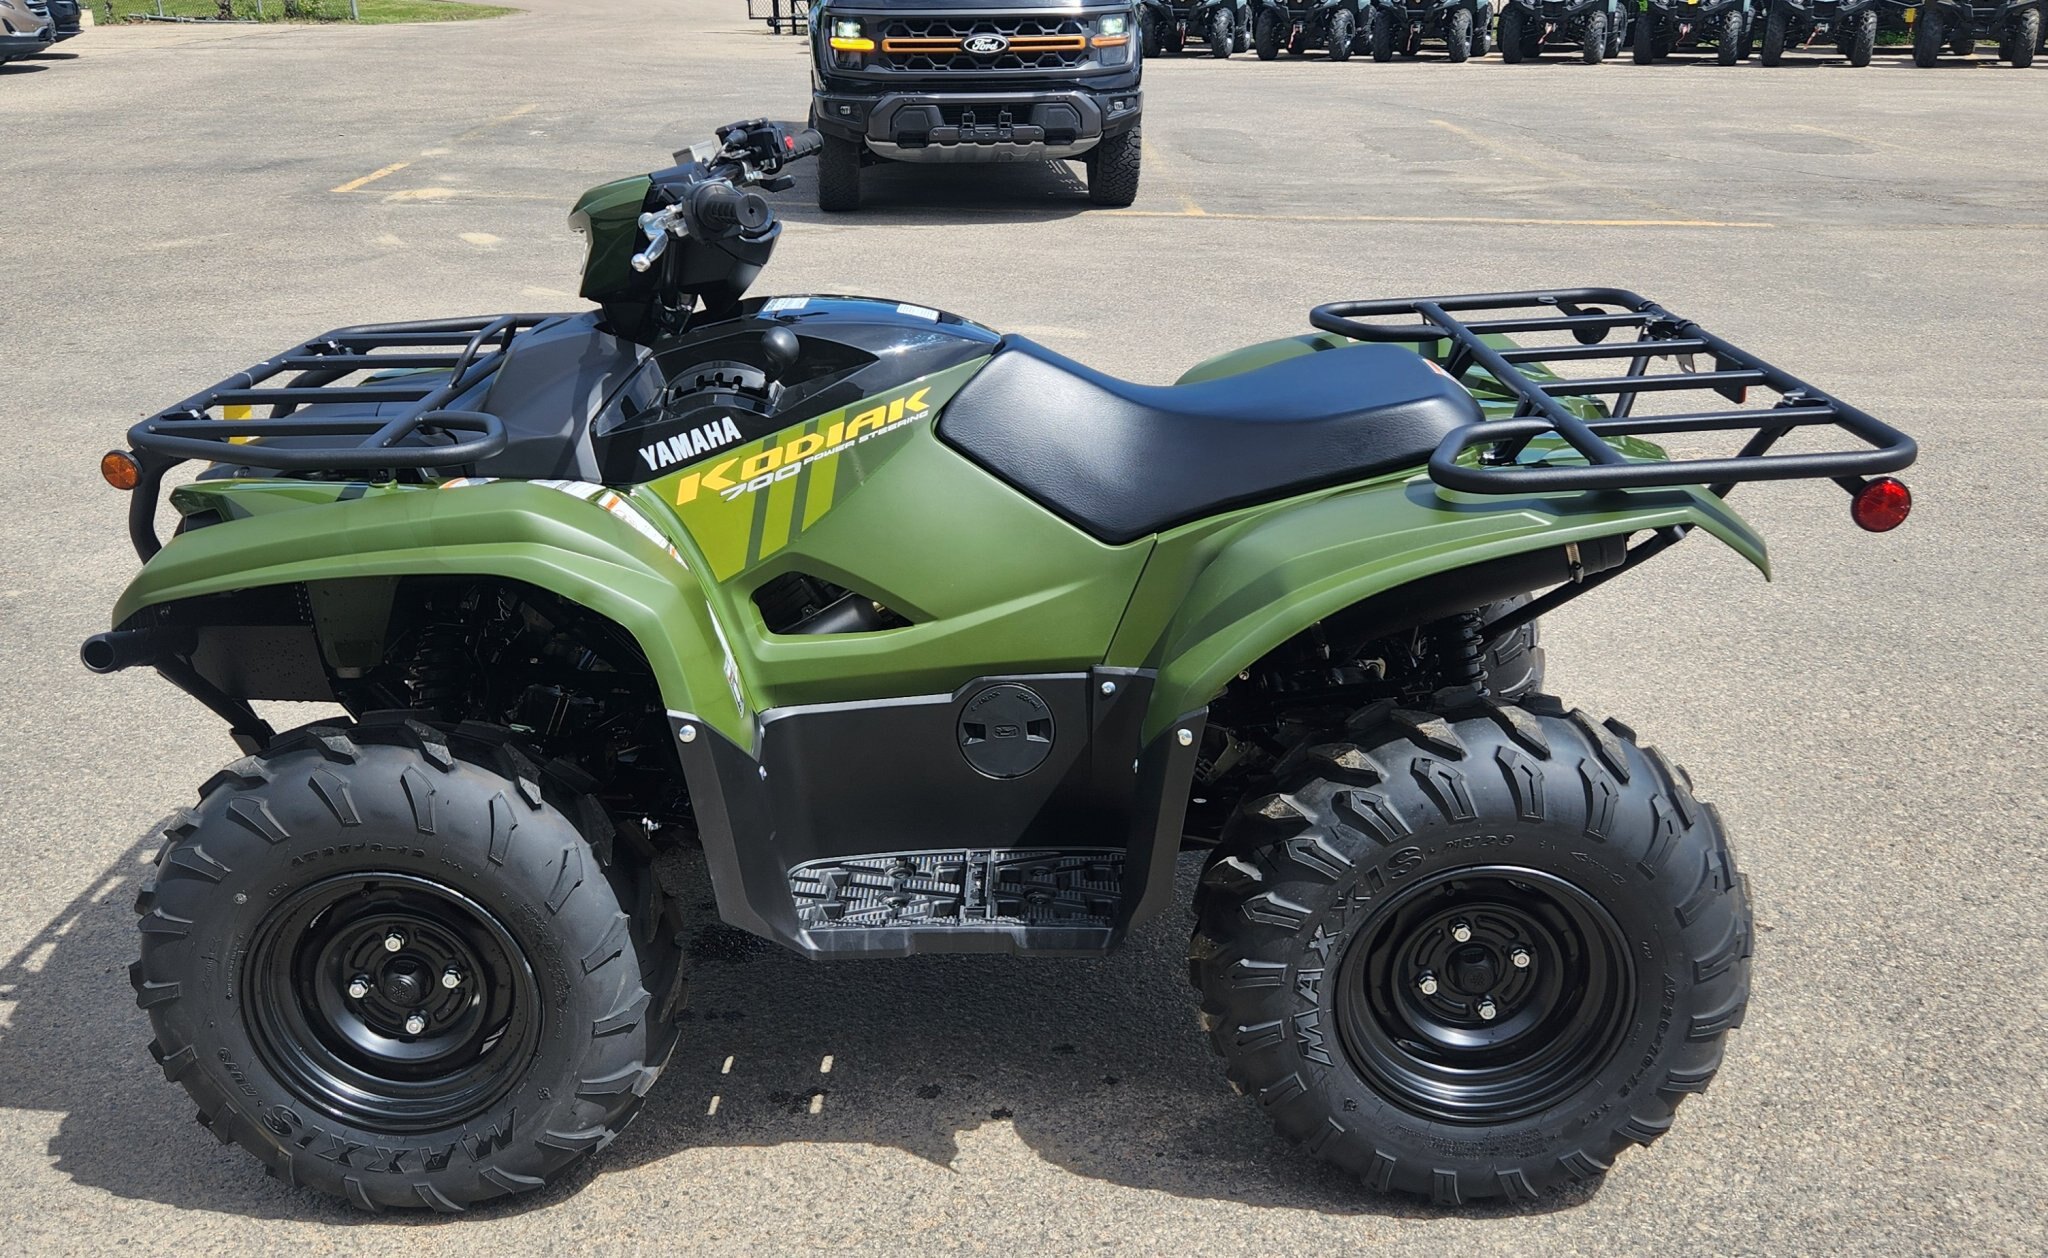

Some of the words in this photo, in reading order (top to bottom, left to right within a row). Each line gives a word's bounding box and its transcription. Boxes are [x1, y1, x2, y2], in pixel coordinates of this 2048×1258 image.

[969, 37, 1001, 51] Ford
[638, 416, 742, 471] YAMAHA
[676, 386, 932, 506] KODIAK
[719, 461, 802, 504] 700
[803, 440, 856, 466] POWER
[858, 410, 929, 444] STEERING
[1295, 843, 1425, 1067] MAXXIS
[261, 1104, 517, 1174] MAXXIS
